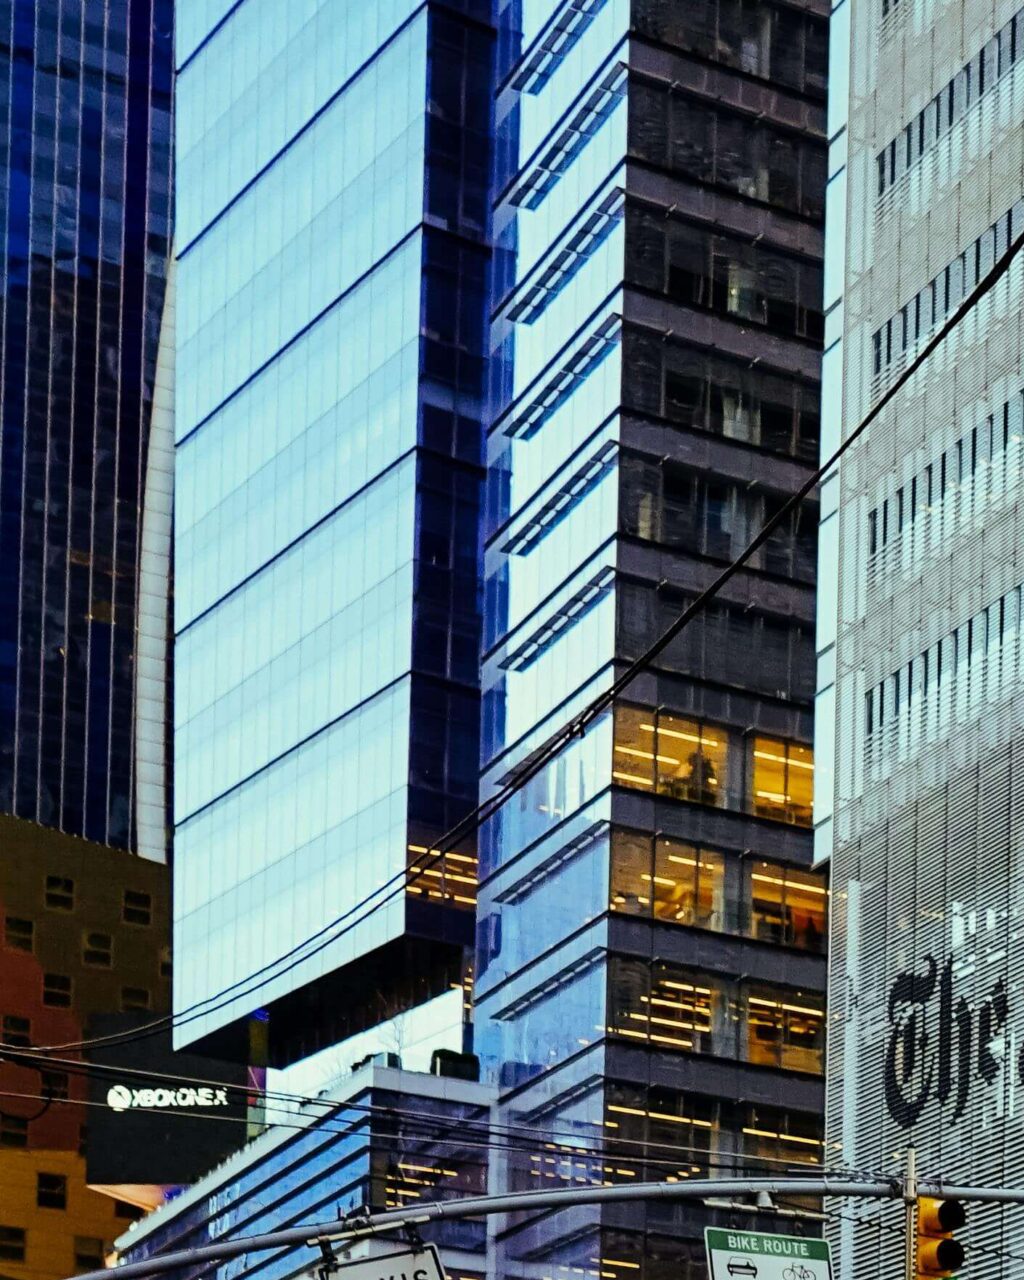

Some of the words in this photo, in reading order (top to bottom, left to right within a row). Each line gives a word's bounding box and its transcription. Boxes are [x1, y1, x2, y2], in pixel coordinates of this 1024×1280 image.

[884, 953, 1008, 1128] The
[132, 1088, 178, 1107] XBOX
[727, 1235, 760, 1252] BIKE
[763, 1239, 809, 1256] ROUTE
